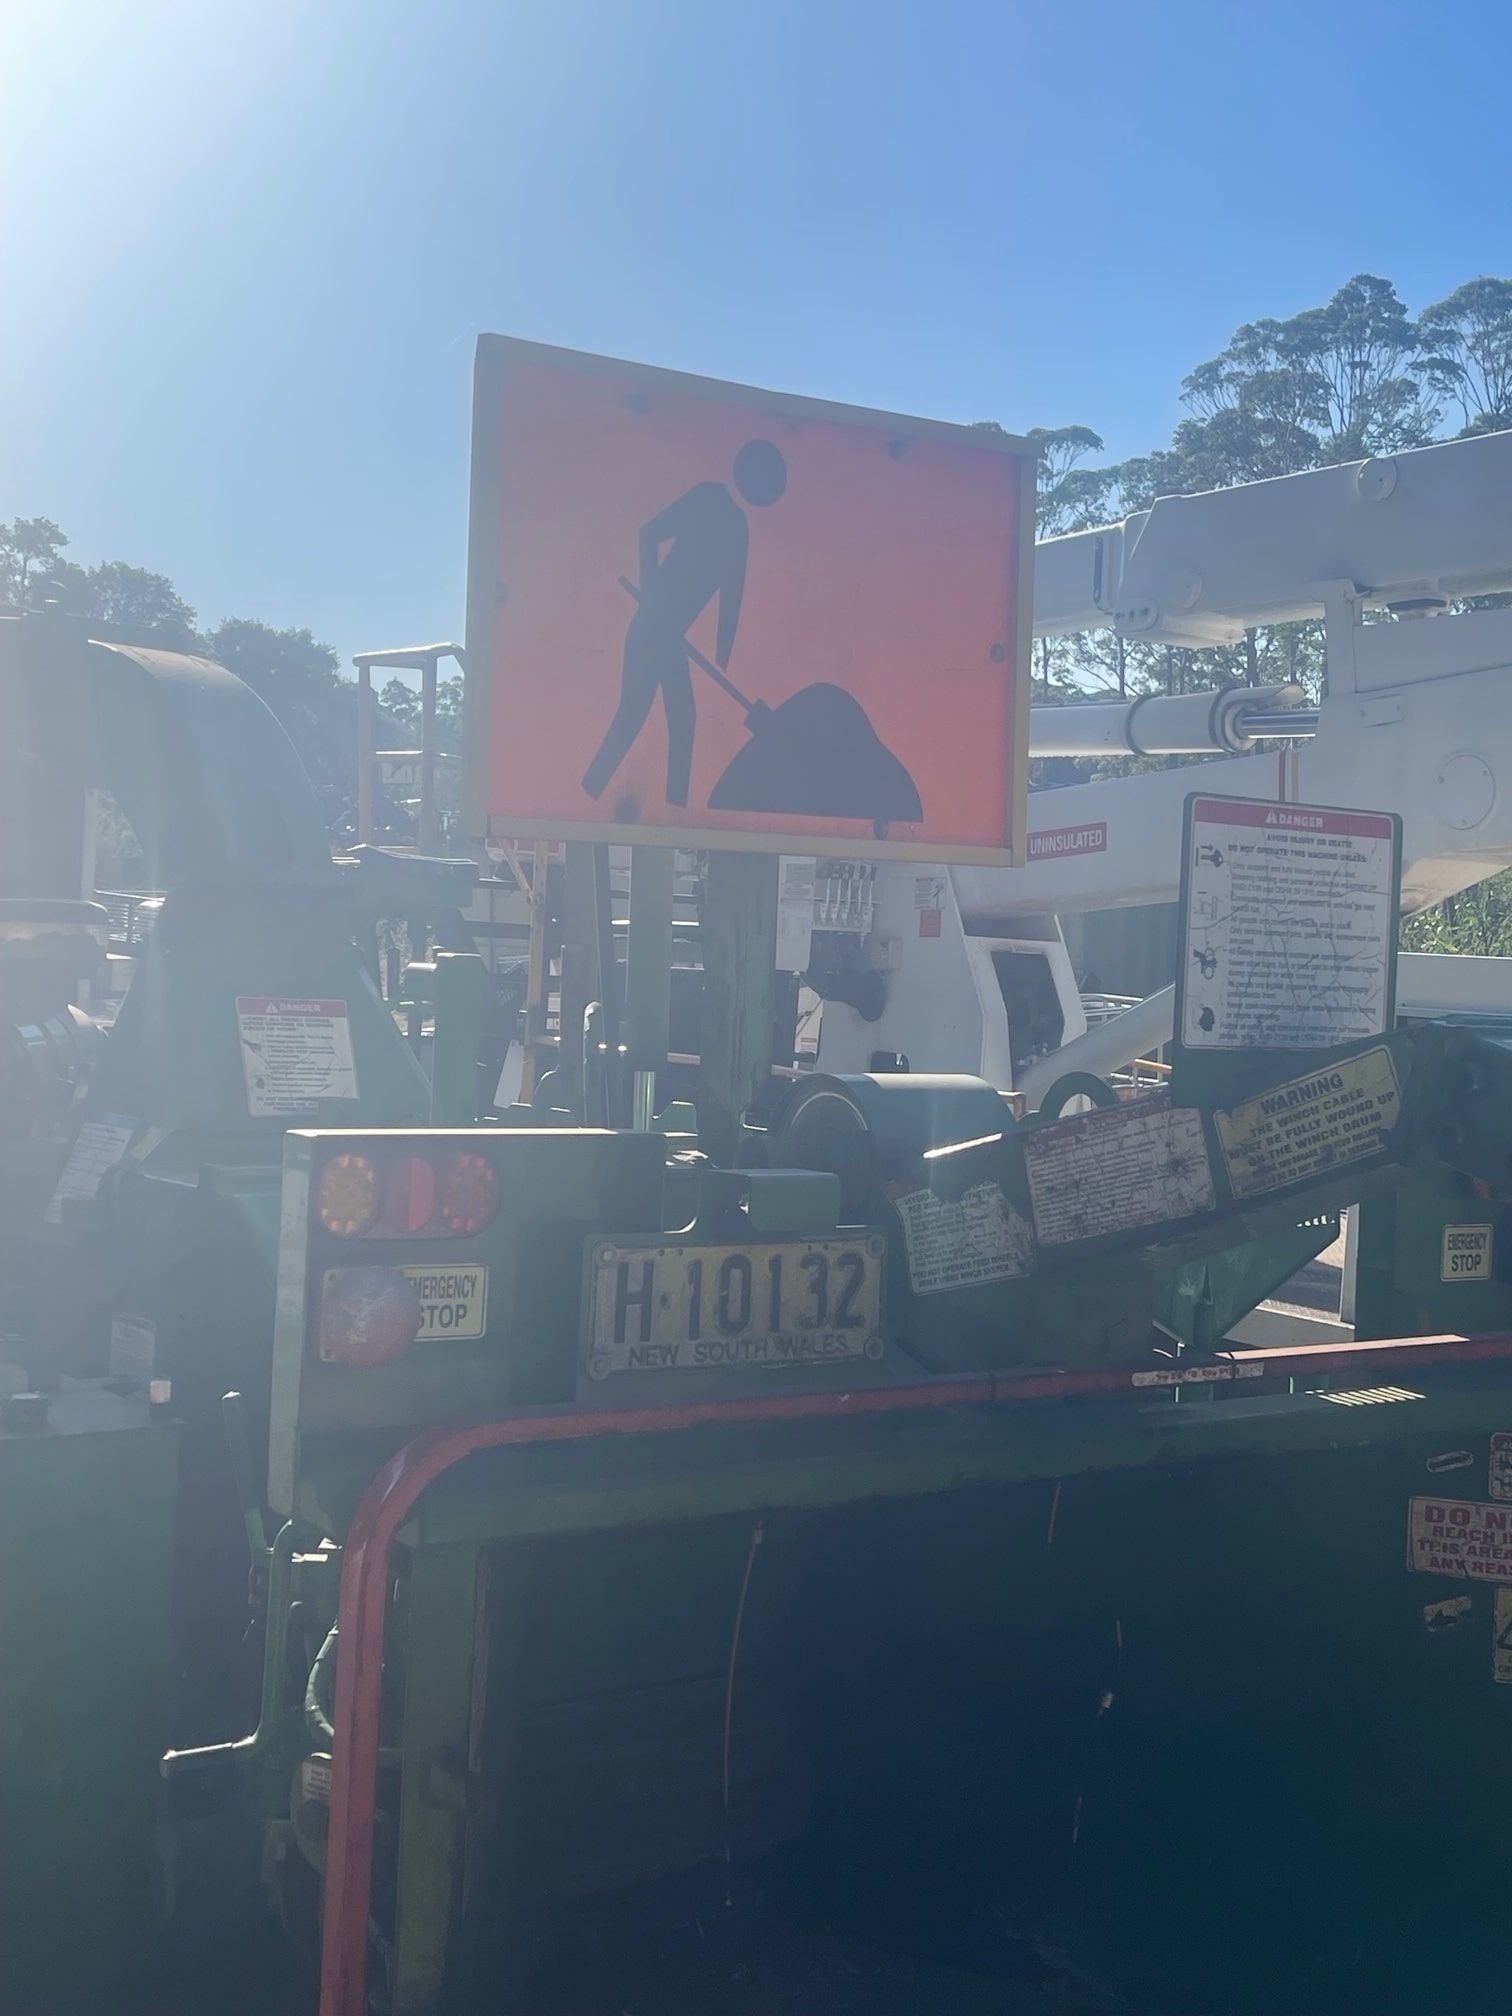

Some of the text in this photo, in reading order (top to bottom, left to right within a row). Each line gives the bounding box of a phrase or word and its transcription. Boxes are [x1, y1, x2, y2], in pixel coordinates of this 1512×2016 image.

[1279, 813, 1324, 828] DANGER
[1030, 829, 1103, 855] UNINSULATED
[1227, 843, 1238, 852] DO
[1240, 844, 1255, 854] NOT
[1257, 846, 1287, 857] OPERATE
[1290, 850, 1305, 859] THIS
[280, 1003, 321, 1012] DANGER
[1260, 1073, 1344, 1115] WARNING
[1249, 1088, 1365, 1138] THE WINCH CABLE
[1228, 1091, 1396, 1160] MUST BE FULLY WOUND UP
[1247, 1111, 1382, 1168] ON THE WINCH DRUM
[1448, 1233, 1487, 1250] EMERGENCY
[942, 1261, 972, 1274] OPERATE
[984, 1264, 1010, 1276] SYSTEM
[1451, 1254, 1482, 1272] STOP
[407, 1276, 477, 1299] MERGENCY
[629, 1335, 849, 1367] NEW SOUTH WALES
[1424, 1505, 1512, 1530] DO N
[1433, 1525, 1495, 1544] REACH
[1417, 1537, 1460, 1555] THIS
[1430, 1556, 1466, 1571] ANY
